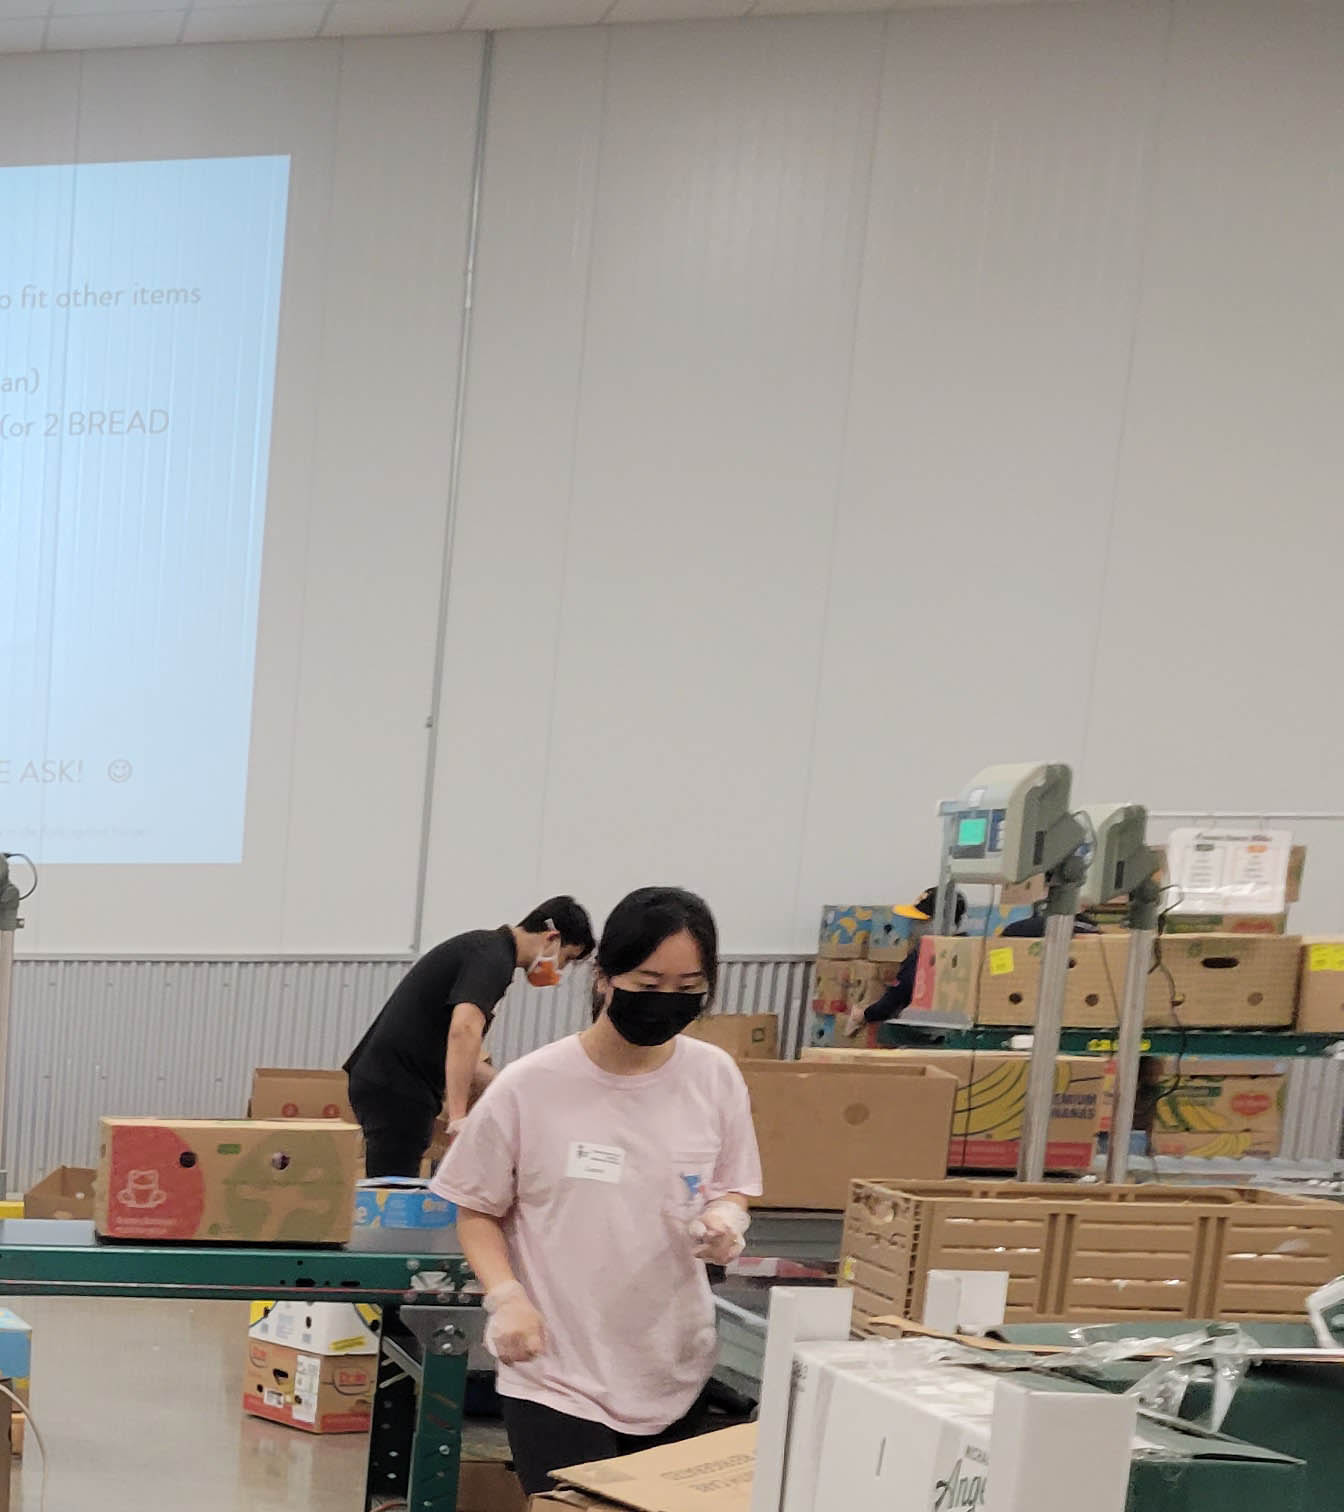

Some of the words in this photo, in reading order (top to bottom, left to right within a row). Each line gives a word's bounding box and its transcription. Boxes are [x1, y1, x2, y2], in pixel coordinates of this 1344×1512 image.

[21, 284, 49, 309] fit
[55, 282, 124, 308] other
[133, 281, 201, 305] items
[68, 408, 171, 436] BREAD
[20, 758, 84, 784] ASK!
